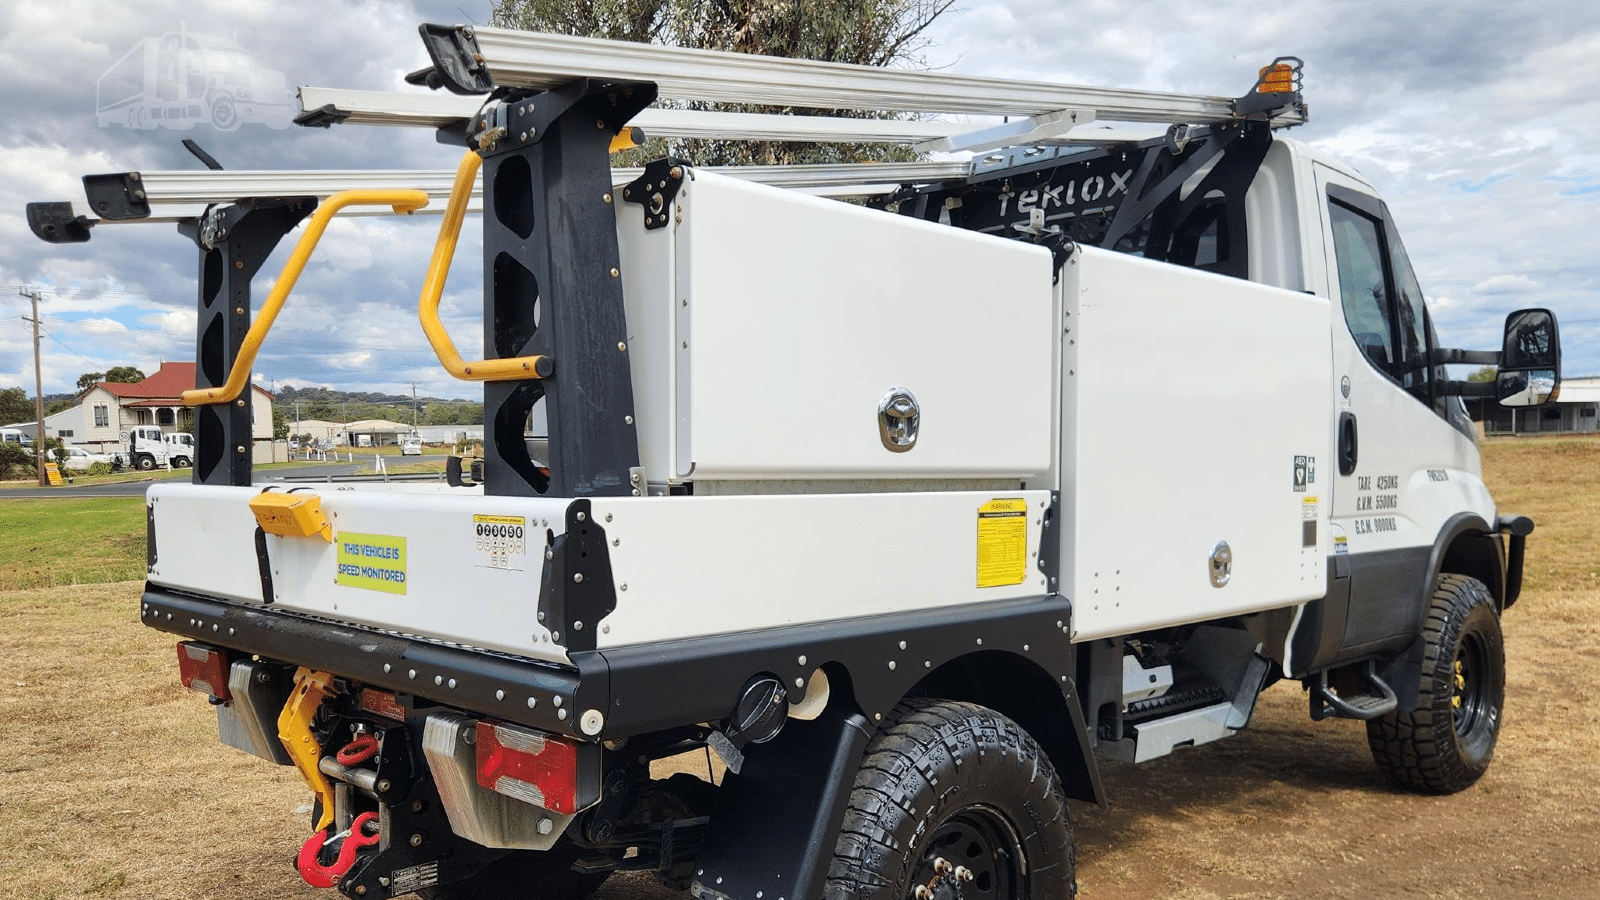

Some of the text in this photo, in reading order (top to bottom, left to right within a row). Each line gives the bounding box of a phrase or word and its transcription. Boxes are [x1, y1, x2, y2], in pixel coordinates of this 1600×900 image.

[1295, 456, 1306, 465] AED
[1358, 475, 1398, 490] TARE 4250KG
[1375, 494, 1397, 510] 5500KG
[1374, 517, 1397, 532] 9000KG
[344, 543, 399, 560] THIS VEHICLE IS
[338, 563, 405, 582] SPEED MONITORED
